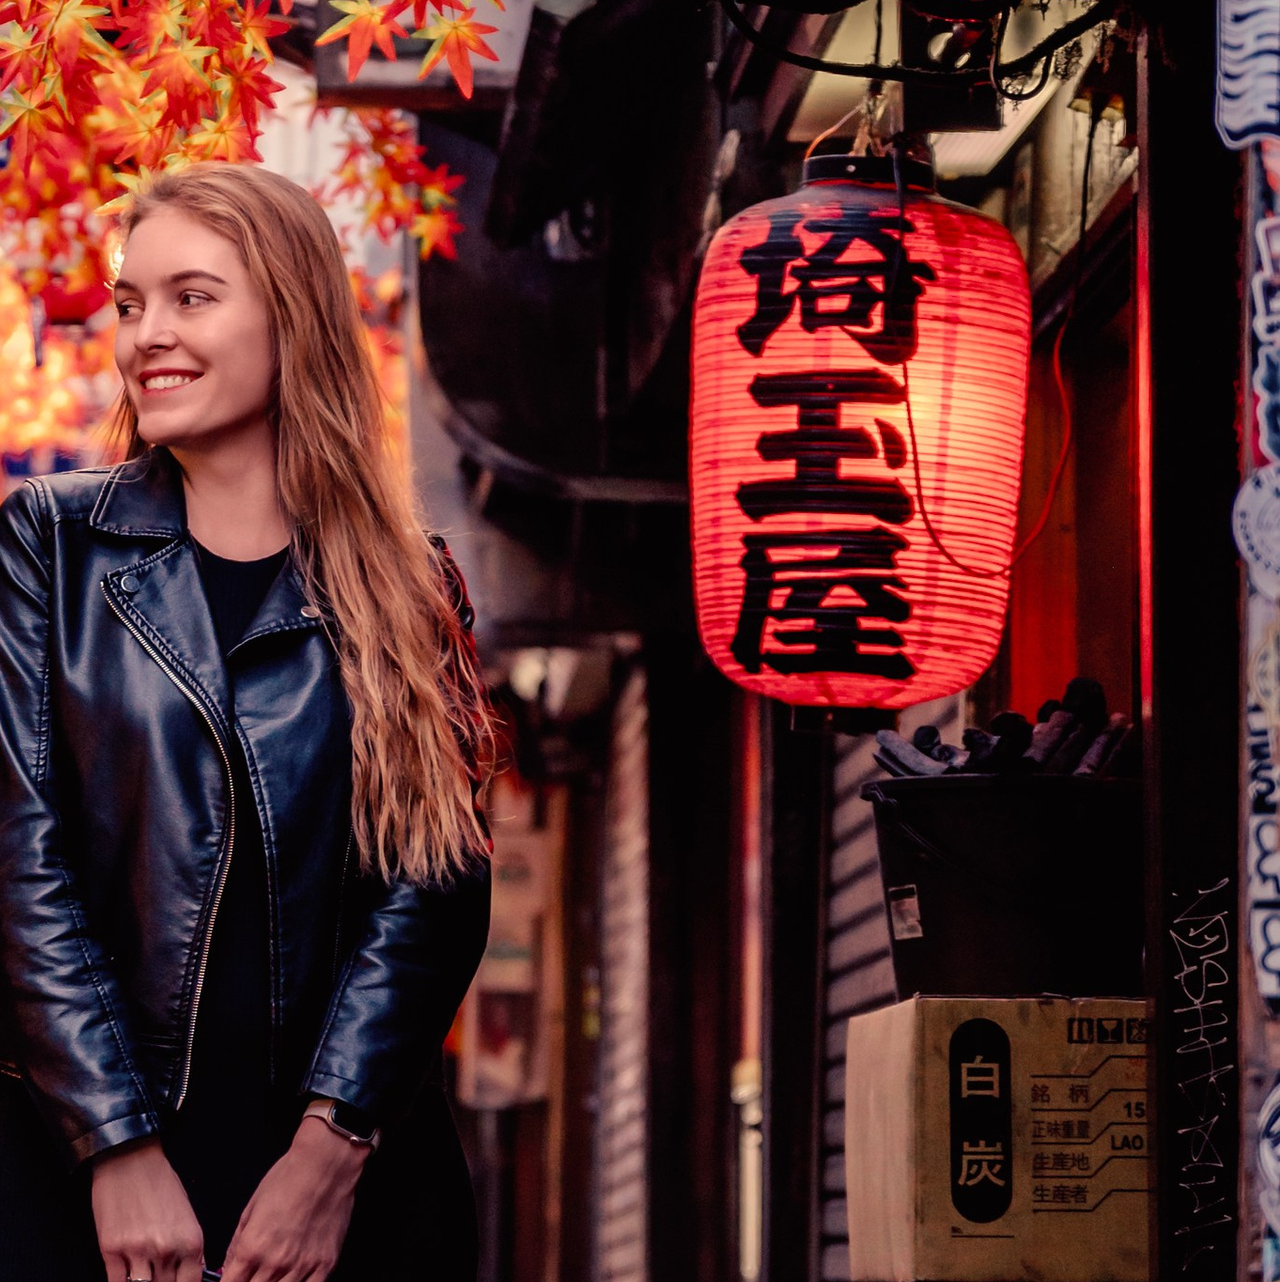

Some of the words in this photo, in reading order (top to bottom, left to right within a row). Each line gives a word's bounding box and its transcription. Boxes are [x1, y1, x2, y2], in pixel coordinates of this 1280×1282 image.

[731, 207, 935, 680] 埼玉屋
[958, 1055, 1006, 1188] 白炭
